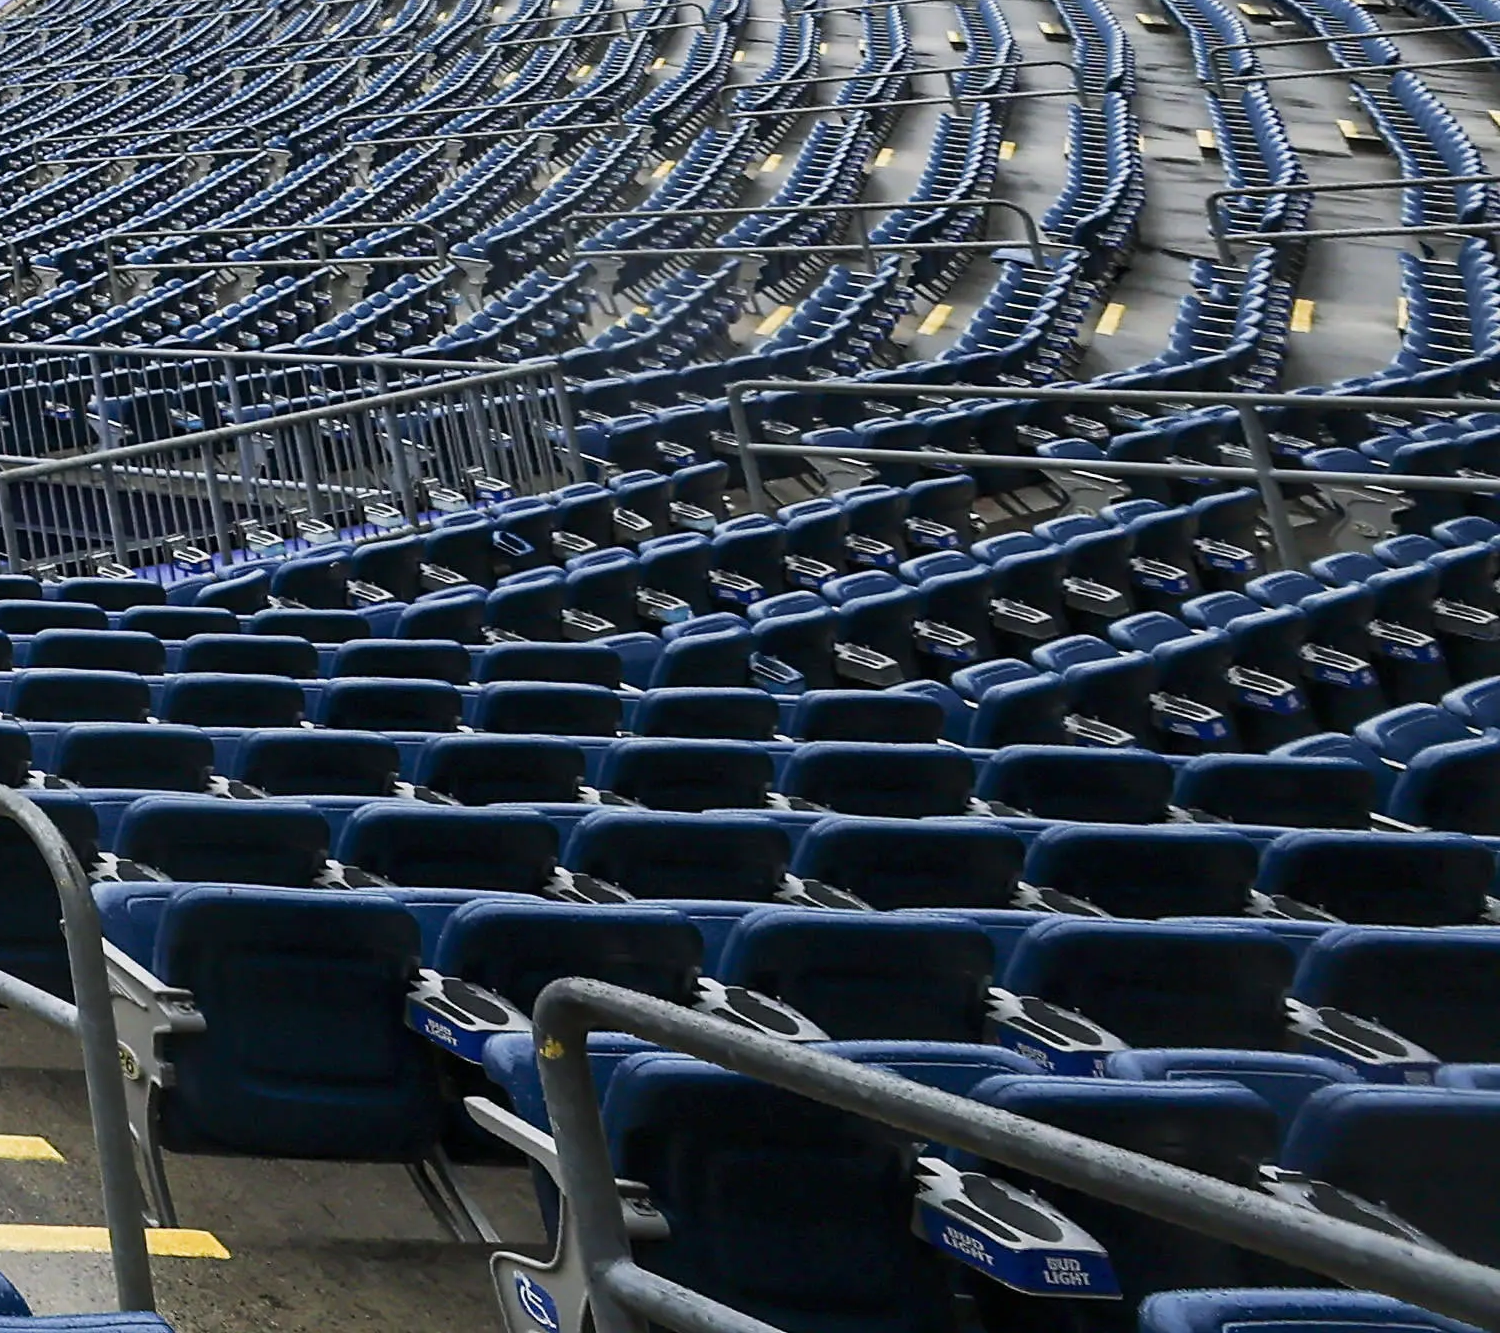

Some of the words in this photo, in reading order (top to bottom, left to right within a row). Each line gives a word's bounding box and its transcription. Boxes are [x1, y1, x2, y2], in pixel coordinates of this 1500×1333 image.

[943, 1233, 994, 1266] LIGHT
[947, 1226, 984, 1252] BUD
[1047, 1256, 1080, 1273] BUD
[1043, 1270, 1090, 1286] LIGHT
